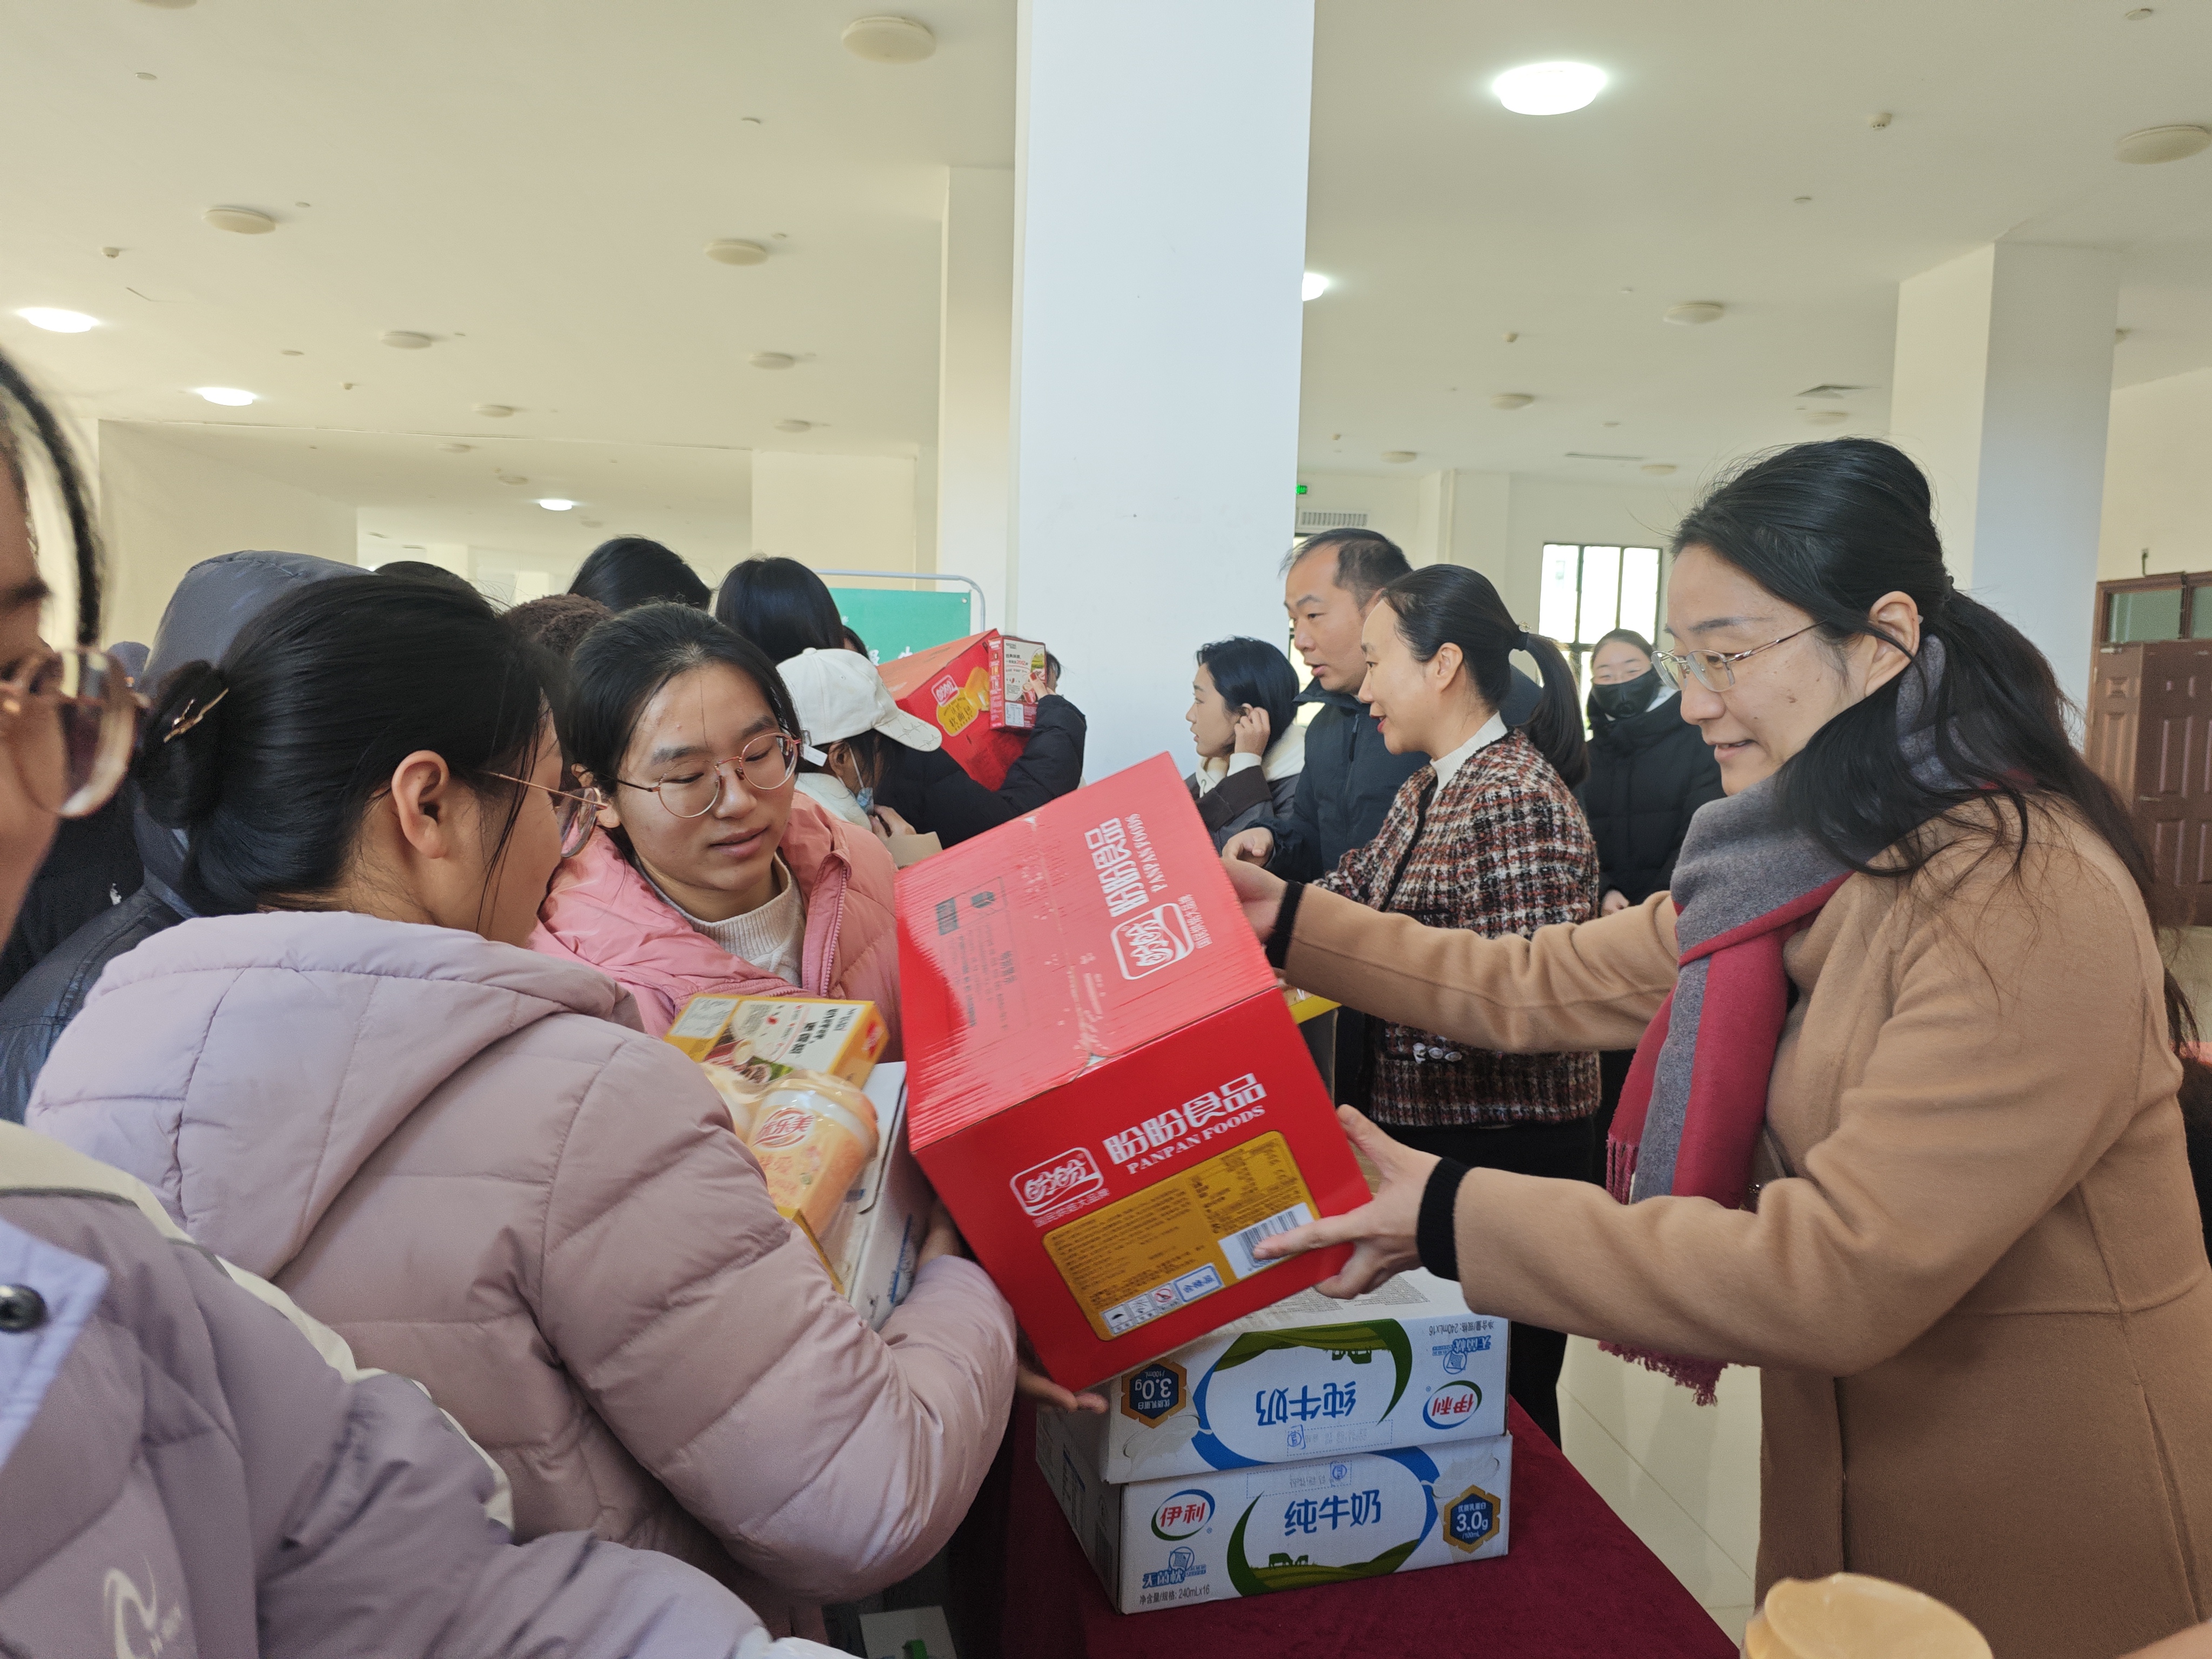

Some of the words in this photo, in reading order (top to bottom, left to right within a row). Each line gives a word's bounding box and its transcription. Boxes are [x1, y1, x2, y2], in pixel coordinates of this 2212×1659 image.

[1124, 813, 1151, 849] FOODS
[1083, 817, 1150, 918] 盼盼食品
[1136, 847, 1168, 893] PANPAN
[1102, 1073, 1267, 1165] 盼盼食品
[1126, 1134, 1202, 1175] PANPAN
[1201, 1105, 1266, 1141] FOODS
[1135, 1378, 1172, 1400] 3.0g
[1256, 1380, 1356, 1426] 纯牛奶
[1432, 1393, 1474, 1417] 伊利
[1159, 1502, 1206, 1528] 伊利
[1284, 1489, 1381, 1536] 纯牛奶
[1456, 1511, 1488, 1532] 3.0g
